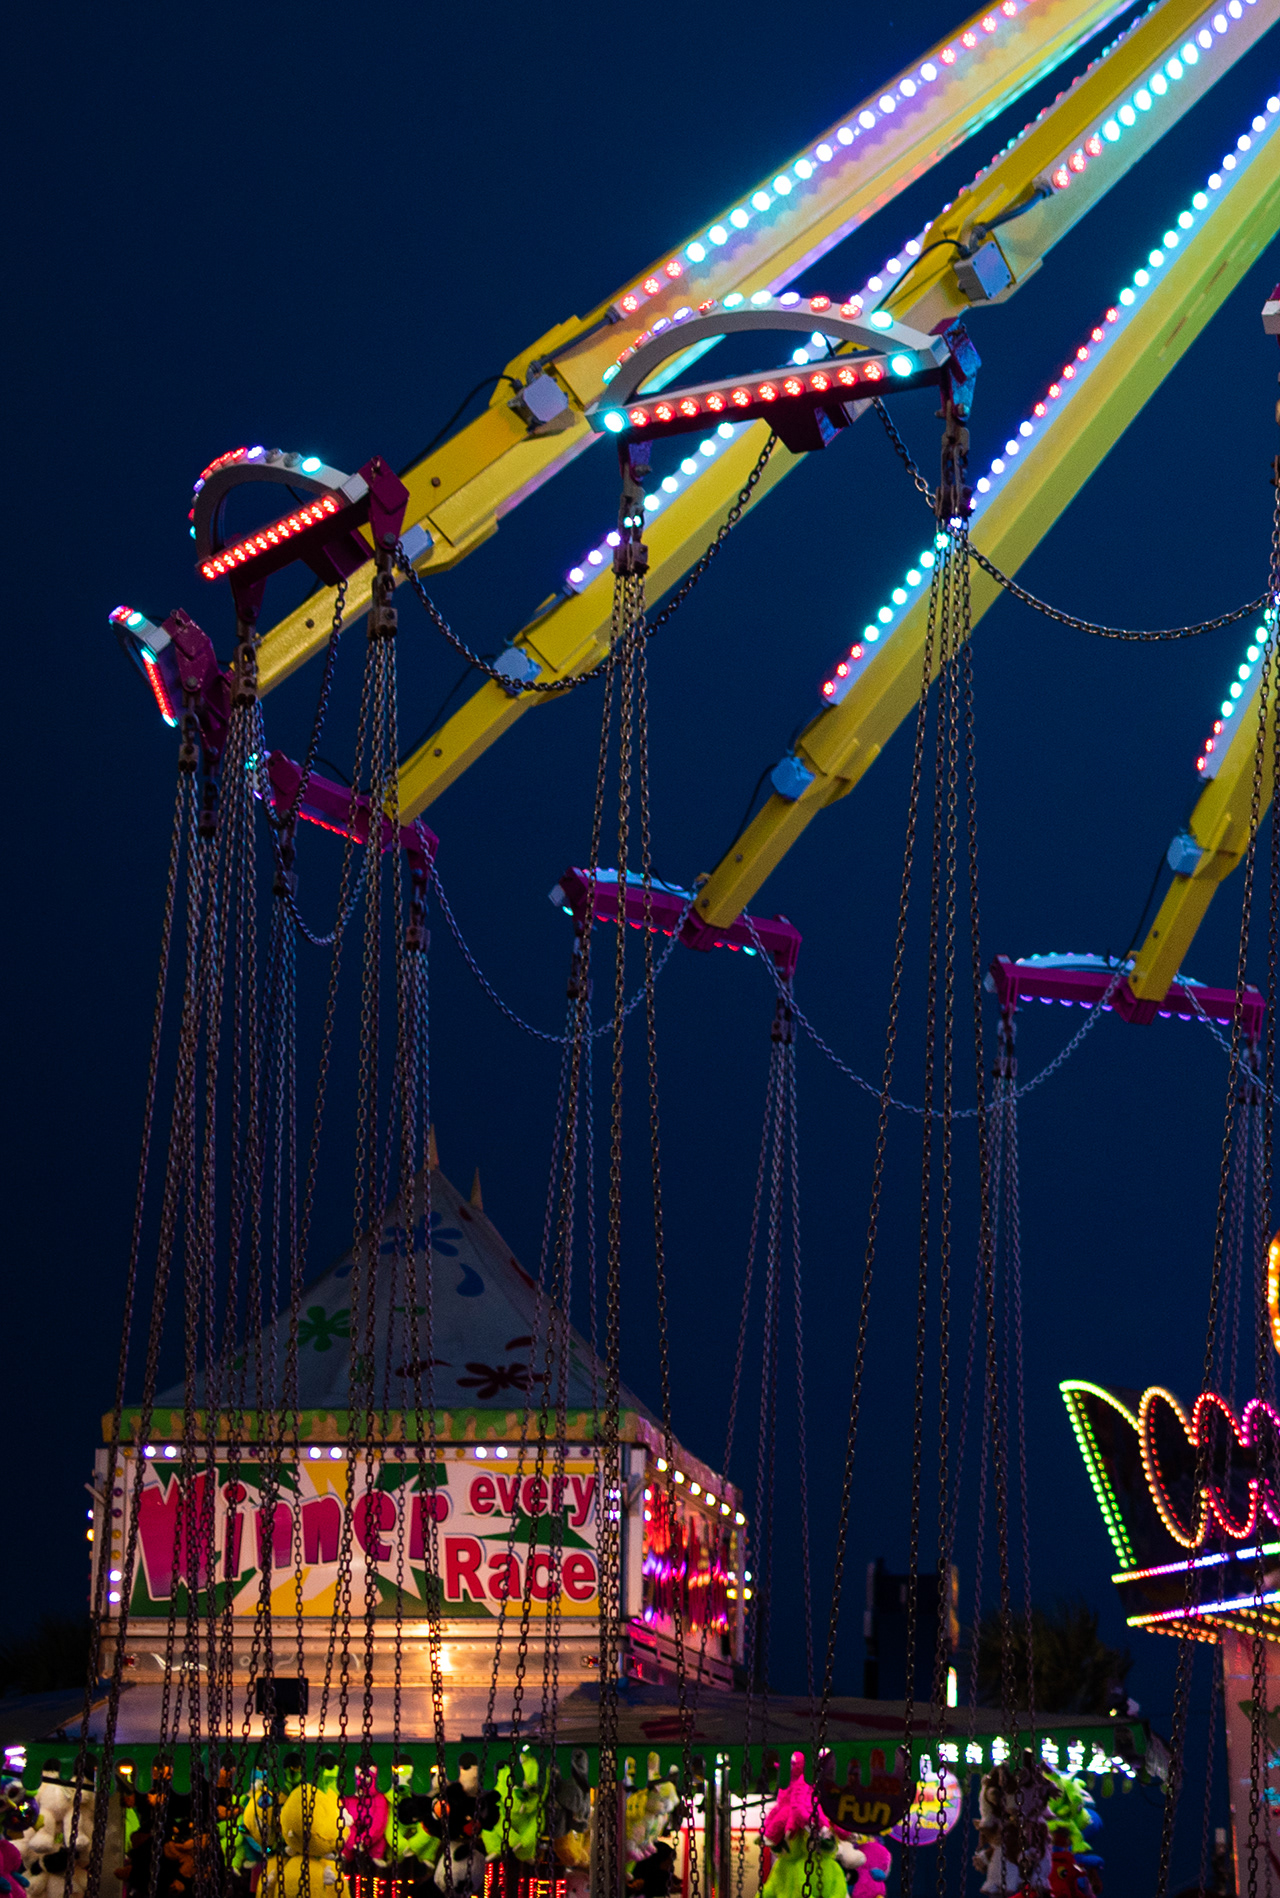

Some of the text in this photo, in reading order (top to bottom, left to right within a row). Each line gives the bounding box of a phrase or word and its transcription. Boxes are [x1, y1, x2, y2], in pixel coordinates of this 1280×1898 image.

[138, 1471, 596, 1598] Winner every
[445, 1536, 598, 1601] Race
[836, 1793, 892, 1827] Fun
